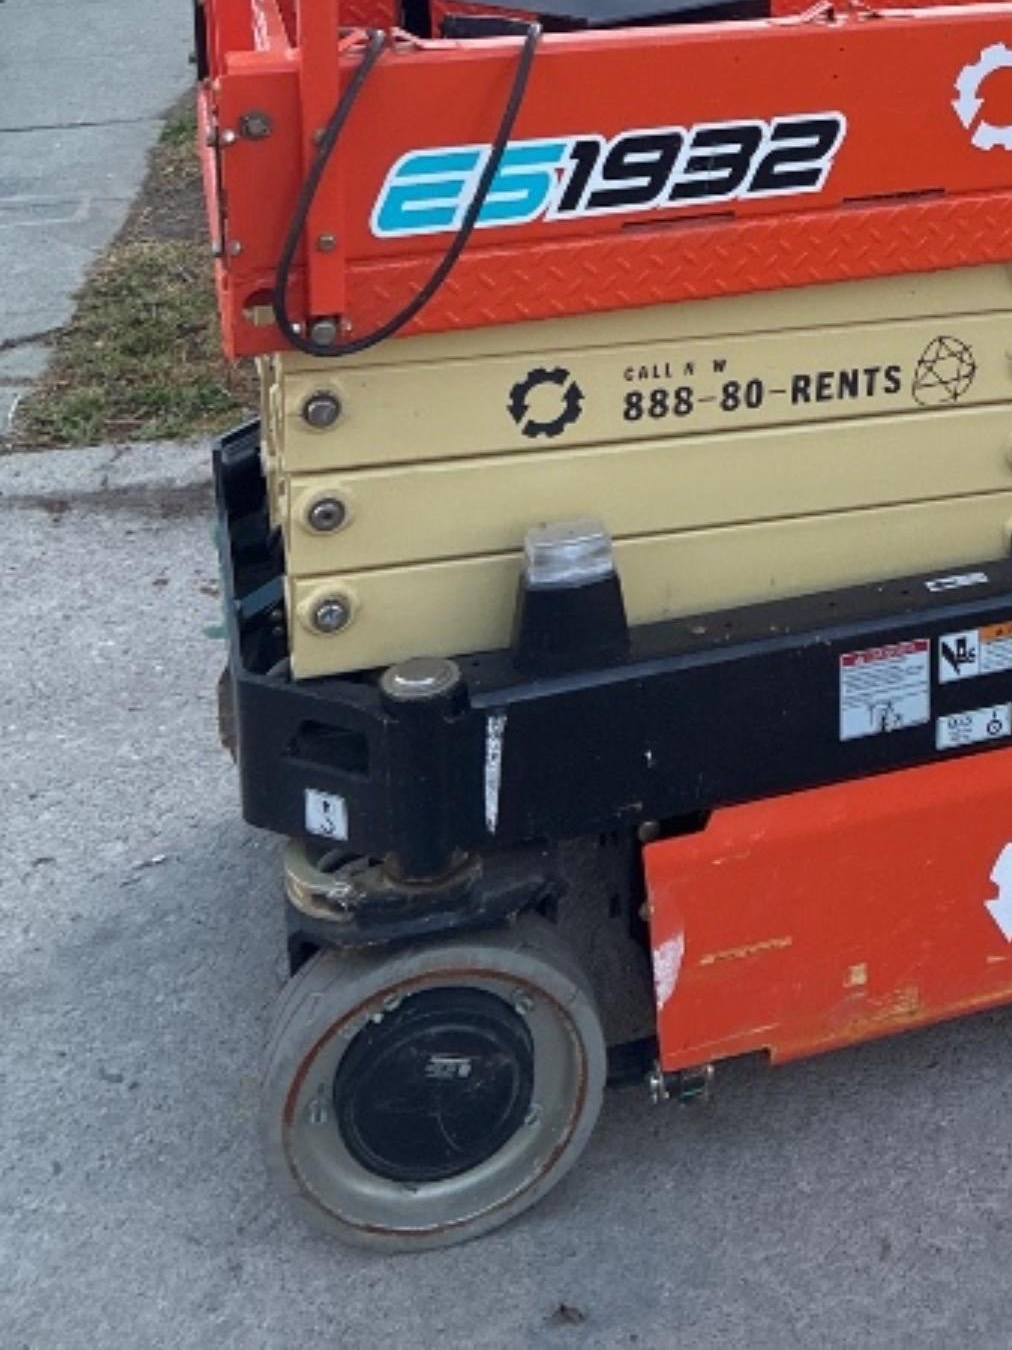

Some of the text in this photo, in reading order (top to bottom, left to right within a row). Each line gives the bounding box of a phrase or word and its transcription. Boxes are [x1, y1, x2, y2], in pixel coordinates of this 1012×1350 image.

[623, 358, 727, 382] CALL NW
[623, 364, 902, 422] 888-80-RENTS
